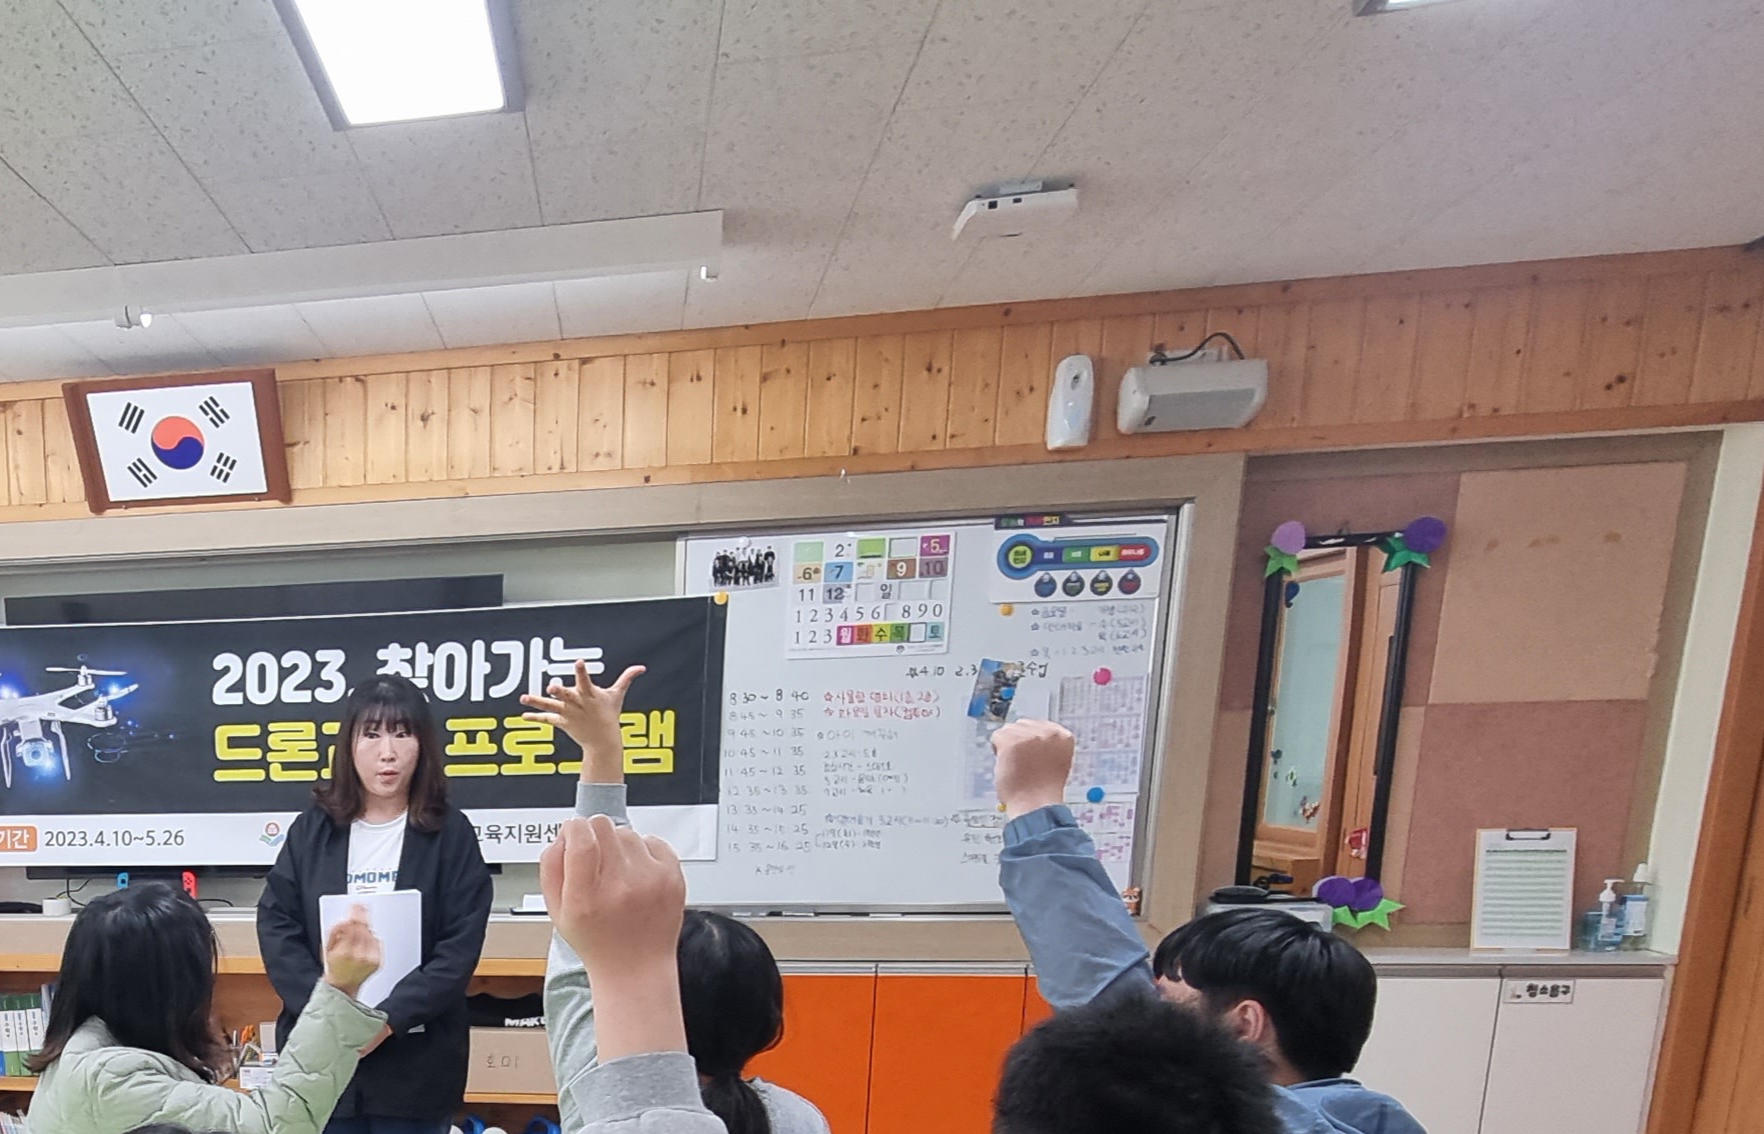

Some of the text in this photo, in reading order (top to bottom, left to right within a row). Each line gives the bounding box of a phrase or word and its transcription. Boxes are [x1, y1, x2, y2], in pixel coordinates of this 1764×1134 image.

[212, 649, 354, 705] 2023
[213, 710, 675, 782] 드론 프로램
[44, 829, 185, 847] 2023.4.10~5.26
[475, 823, 562, 845] 육지원센
